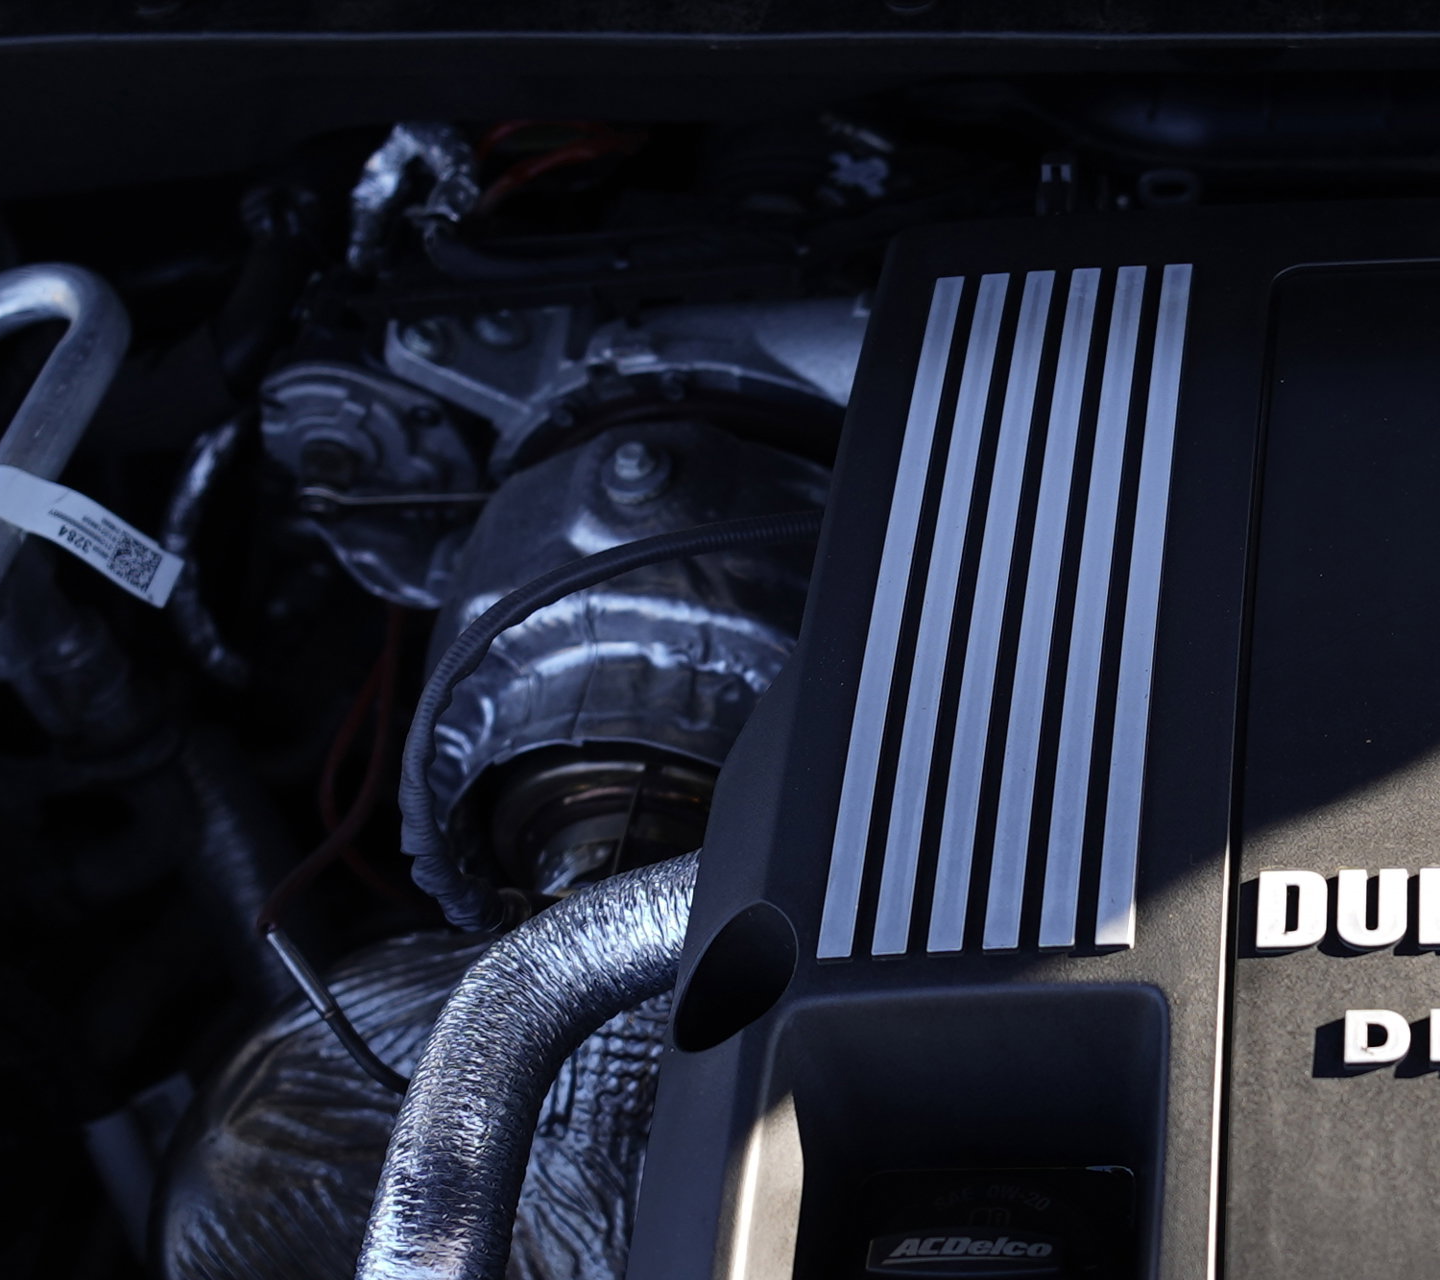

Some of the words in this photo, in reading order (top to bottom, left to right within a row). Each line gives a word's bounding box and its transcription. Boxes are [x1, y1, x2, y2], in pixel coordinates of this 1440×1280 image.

[58, 524, 92, 554] 3284
[932, 1188, 976, 1211] SAE
[986, 1183, 1052, 1211] 0W-20
[888, 1236, 1053, 1258] ACDelco
